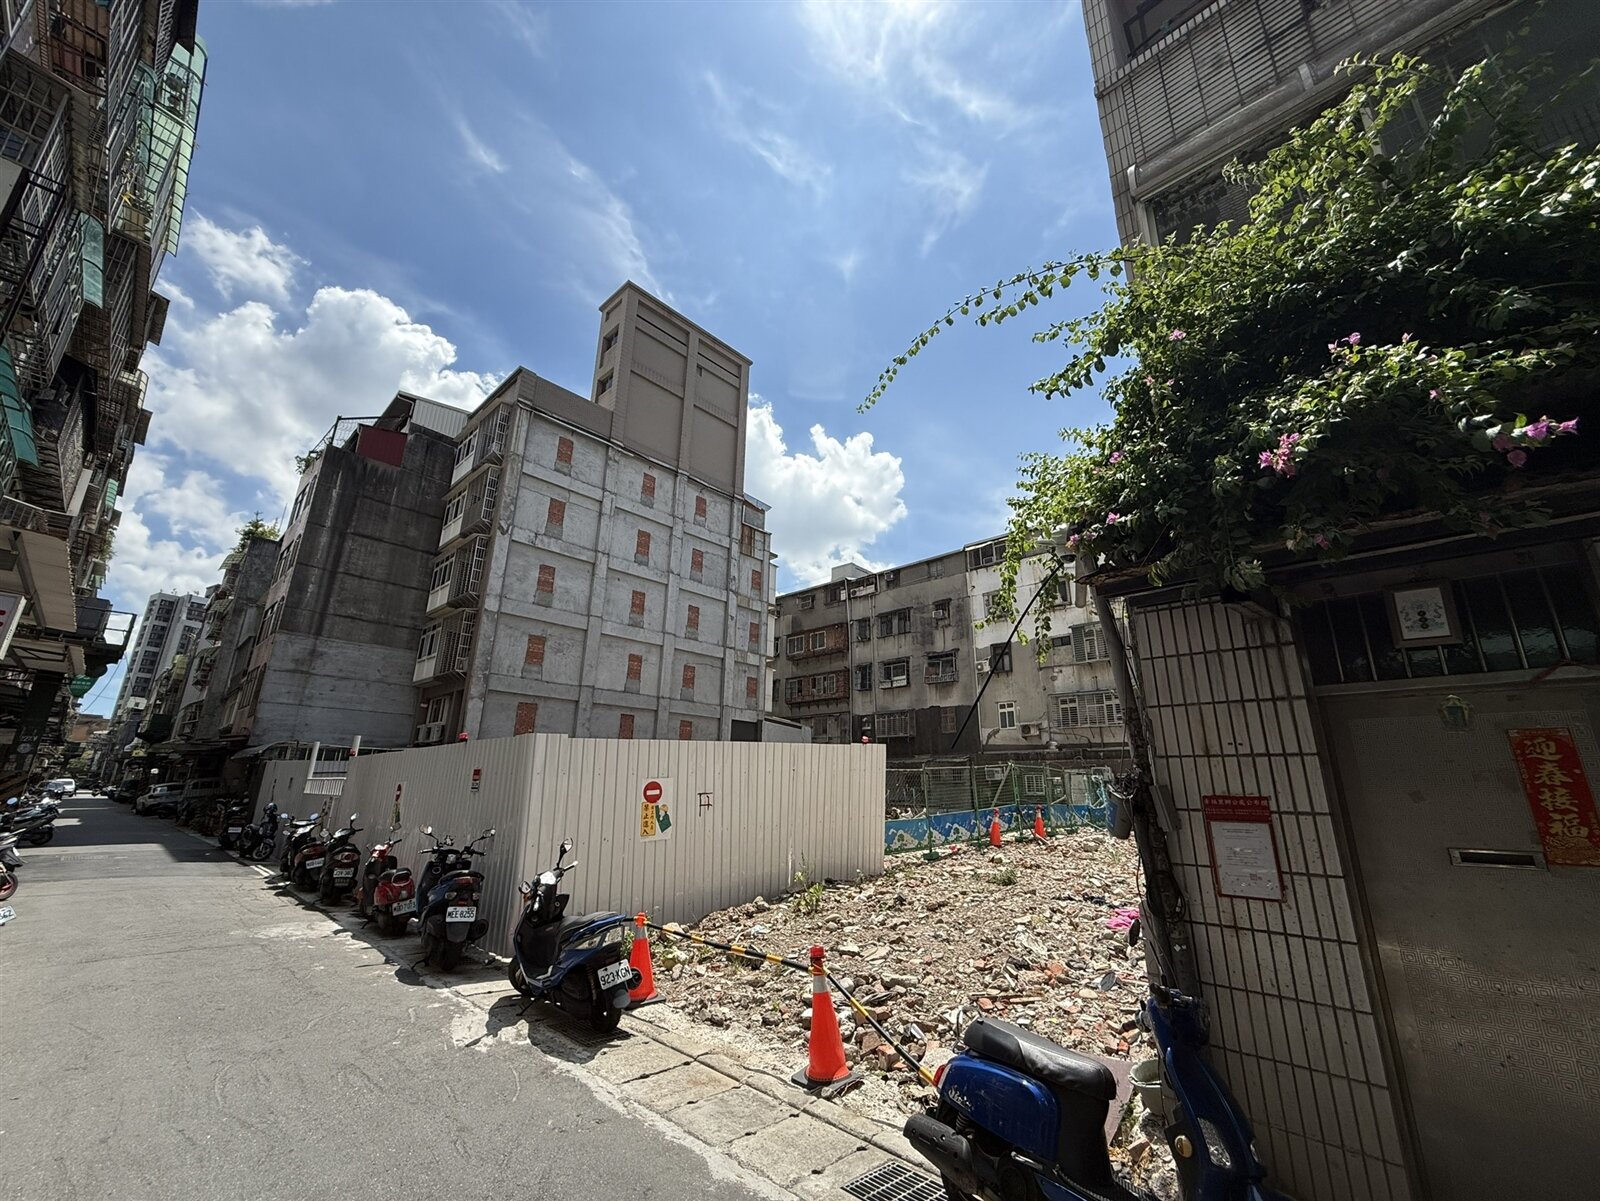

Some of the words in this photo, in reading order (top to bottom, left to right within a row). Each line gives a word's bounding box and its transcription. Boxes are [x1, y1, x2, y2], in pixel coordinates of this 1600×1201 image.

[1523, 736, 1591, 838] 迎春接福
[600, 965, 631, 986] 923-KGN
